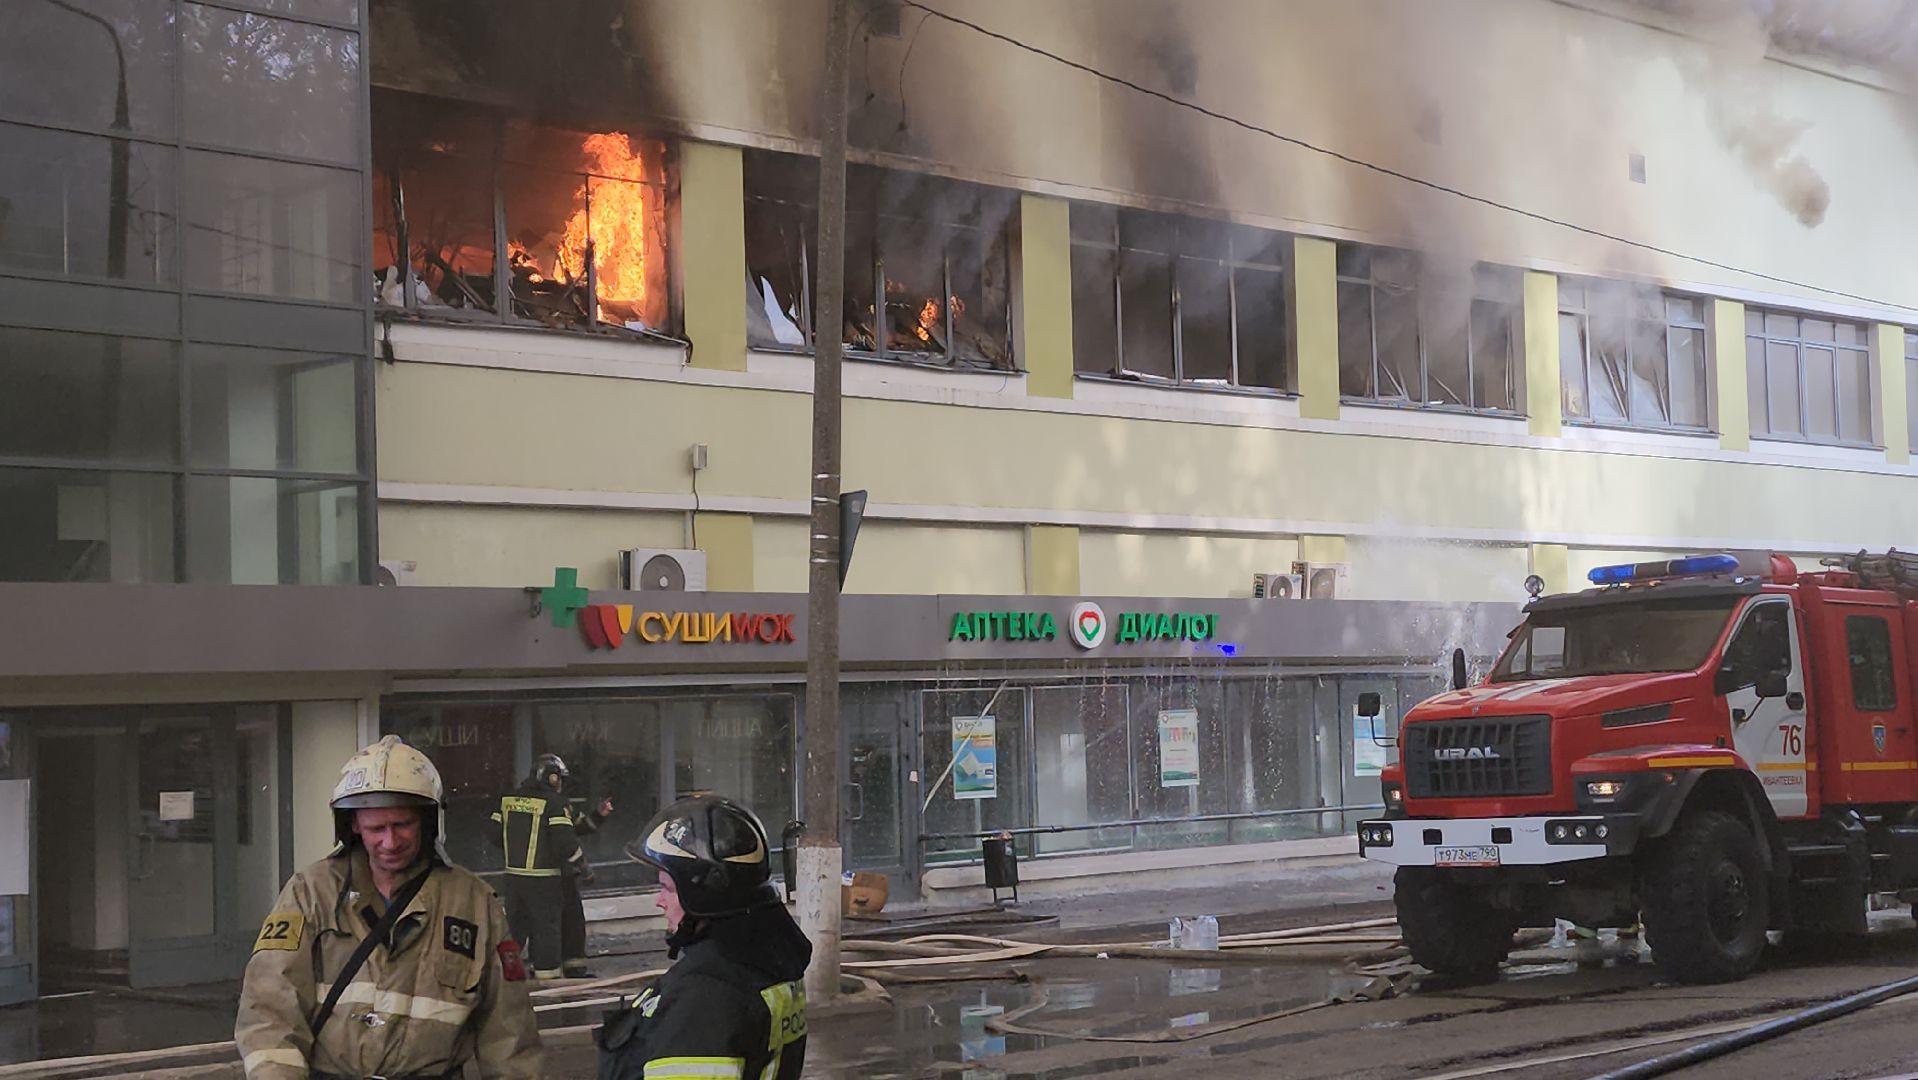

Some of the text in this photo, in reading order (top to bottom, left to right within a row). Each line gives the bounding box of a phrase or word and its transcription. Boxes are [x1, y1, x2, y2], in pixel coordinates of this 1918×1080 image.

[950, 612, 1220, 643] АПТЕКА ДИАЛОГ
[1434, 746, 1500, 760] URAL
[1779, 725, 1802, 755] 76
[261, 921, 290, 940] 22
[449, 924, 472, 950] 80
